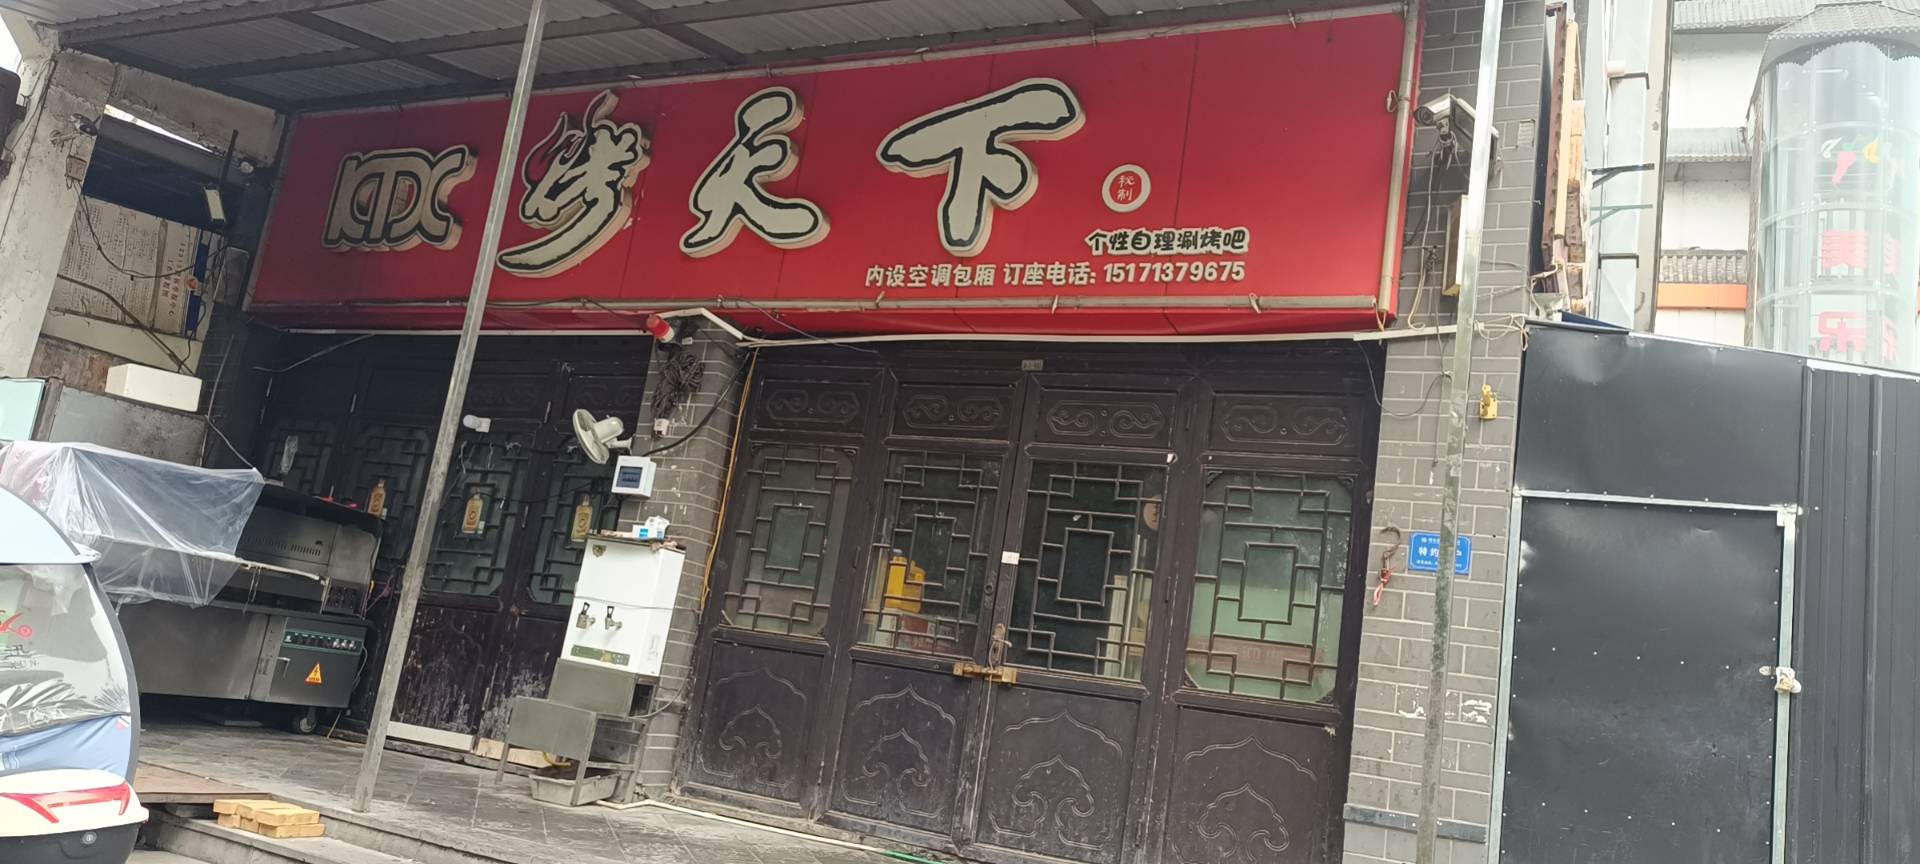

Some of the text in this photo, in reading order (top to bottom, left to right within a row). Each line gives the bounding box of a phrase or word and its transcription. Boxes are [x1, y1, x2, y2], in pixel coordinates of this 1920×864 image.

[1086, 227, 1251, 255] 个性自理涮烤吧
[864, 263, 996, 288] 内设空调包厢
[1102, 260, 1246, 284] 15171379675
